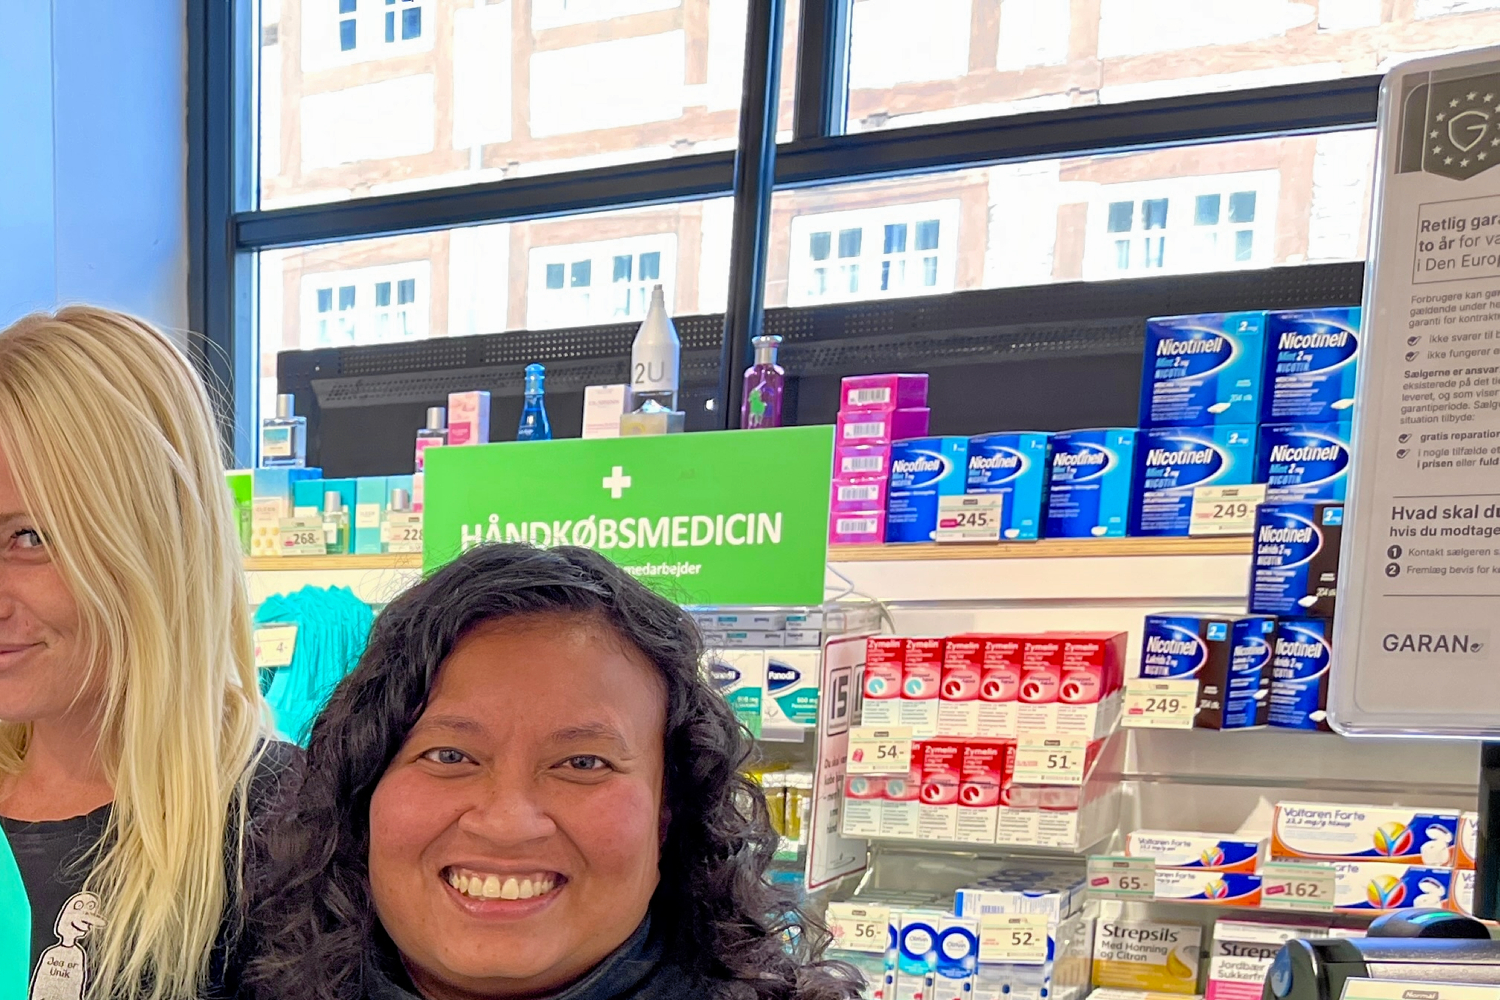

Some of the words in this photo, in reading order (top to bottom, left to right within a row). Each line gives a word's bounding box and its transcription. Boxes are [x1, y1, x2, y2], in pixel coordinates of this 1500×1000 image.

[1421, 217, 1466, 232] Retlig
[1471, 215, 1500, 230] gar
[1419, 241, 1434, 252] to
[1439, 236, 1455, 250] år
[1459, 235, 1481, 248] for
[1426, 258, 1455, 271] Den
[1411, 293, 1462, 304] Forbrugere
[1465, 291, 1482, 299] kan
[1410, 305, 1456, 317] gældende
[1459, 302, 1487, 311] under
[1408, 317, 1441, 329] garanti
[1444, 316, 1456, 324] for
[1279, 331, 1348, 350] Nicotinell
[1429, 334, 1448, 343] ikke
[1451, 332, 1481, 342] svarer
[1484, 331, 1493, 339] til
[1157, 337, 1223, 356] Nicotinell
[1427, 350, 1446, 359] ikke
[1449, 348, 1490, 359] fungerer
[1405, 369, 1450, 380] Sælgerne
[1403, 379, 1456, 390] eksisterede
[1459, 377, 1471, 389] på
[1474, 378, 1489, 387] det
[1438, 392, 1450, 401] og
[1453, 391, 1473, 399] som
[1476, 389, 1499, 398] viser
[1400, 415, 1438, 424] situation
[1420, 432, 1449, 443] gratis
[1146, 448, 1213, 466] Nicotinell
[1270, 445, 1340, 462] Nicotinell
[1423, 448, 1449, 458] nogle
[1453, 446, 1487, 455] tilfælde
[969, 453, 1018, 469] Nicotinell
[1052, 450, 1104, 467] Nicotinell
[1422, 459, 1453, 470] prisen
[1456, 459, 1477, 467] eller
[1479, 458, 1499, 466] fuld
[892, 457, 941, 473] Nicotinell
[1392, 505, 1437, 520] Hvad
[1442, 505, 1479, 519] skal
[461, 512, 782, 551] HÅNDKØBSMEDICIN
[1259, 525, 1313, 544] Nicotinell
[1390, 526, 1416, 537] hvis
[1420, 525, 1436, 536] du
[1408, 548, 1444, 557] Kontakt
[1447, 548, 1491, 558] sælgeren
[1407, 565, 1446, 576] Fremlæg
[1449, 565, 1474, 574] bevis
[1477, 565, 1491, 573] for
[868, 639, 900, 650] Zymelin
[906, 639, 940, 650] Zymelin
[946, 641, 980, 651] Zymelin
[984, 641, 1019, 651] Zymelin
[1025, 643, 1059, 652] Zymelin
[1065, 643, 1099, 652] Zymelin
[1147, 636, 1198, 656] Nicotinell
[768, 671, 796, 680] Panodil
[925, 745, 958, 755] Zymelin
[964, 746, 998, 757] Zymelin
[1284, 807, 1333, 820] Voltaren
[1335, 809, 1365, 822] Forte
[1138, 838, 1168, 847] Voltaren
[1102, 924, 1178, 943] Strepsils
[1101, 940, 1122, 949] Med
[1125, 943, 1168, 955] Honning
[47, 957, 64, 966] Jeg
[1101, 952, 1113, 960] og
[1117, 952, 1147, 961] Citron
[1218, 960, 1265, 971] Jordbær
[50, 968, 70, 978] Unik
[1405, 991, 1437, 999] Normal
